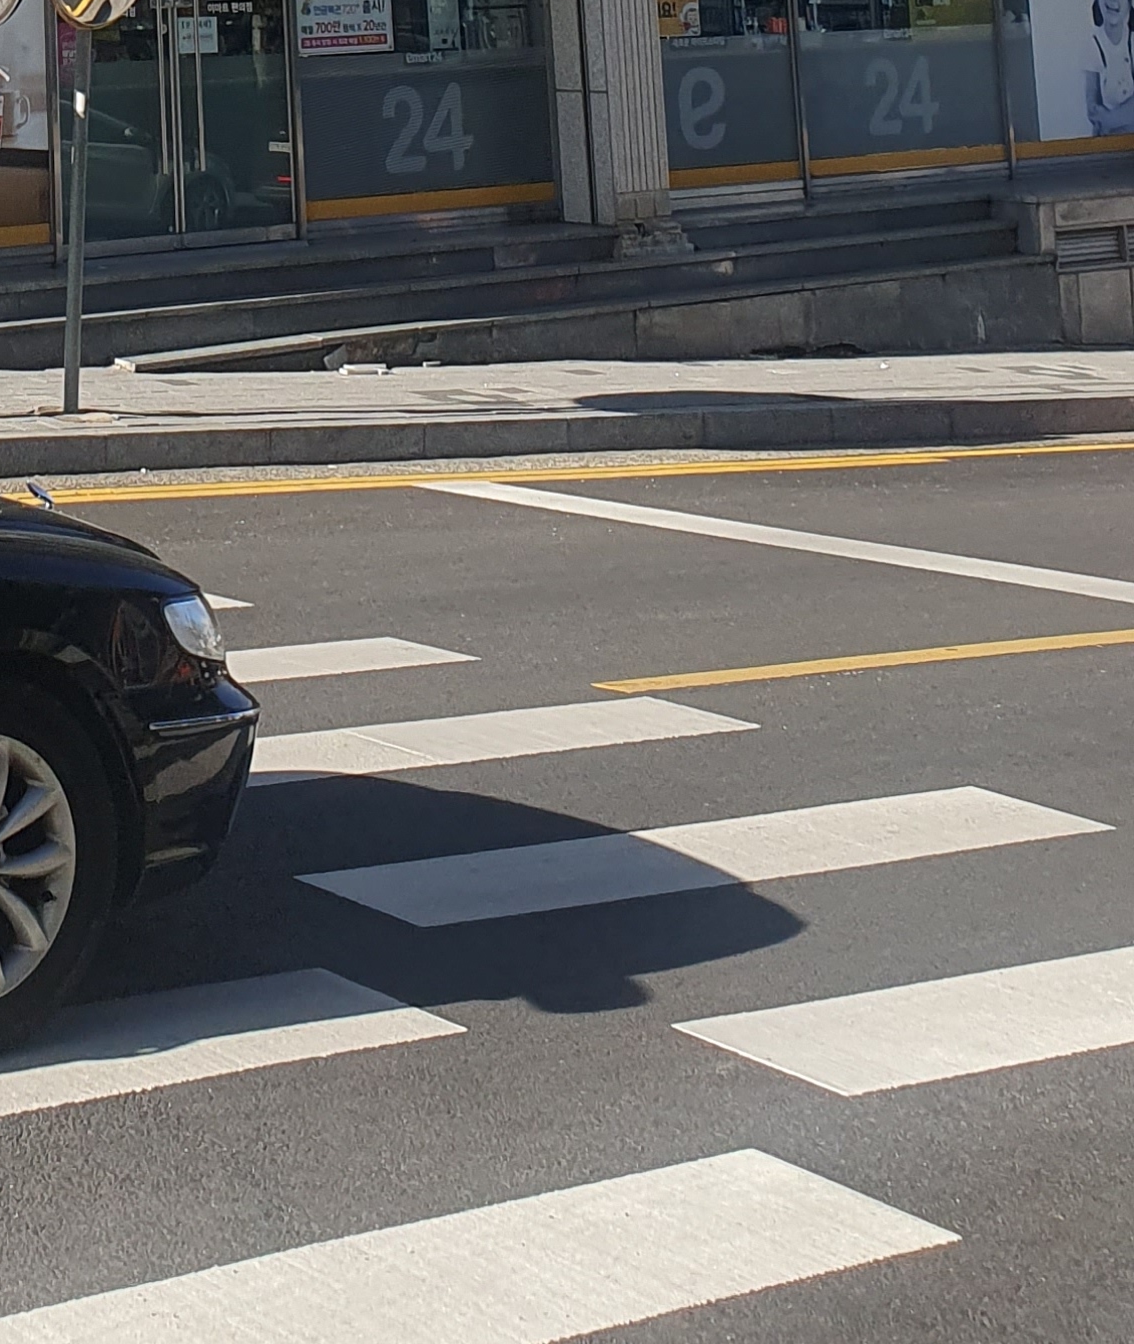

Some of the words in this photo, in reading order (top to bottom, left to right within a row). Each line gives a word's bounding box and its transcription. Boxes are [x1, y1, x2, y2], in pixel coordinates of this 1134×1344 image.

[381, 82, 474, 175] 24
[677, 66, 727, 151] e
[866, 55, 940, 137] 24
